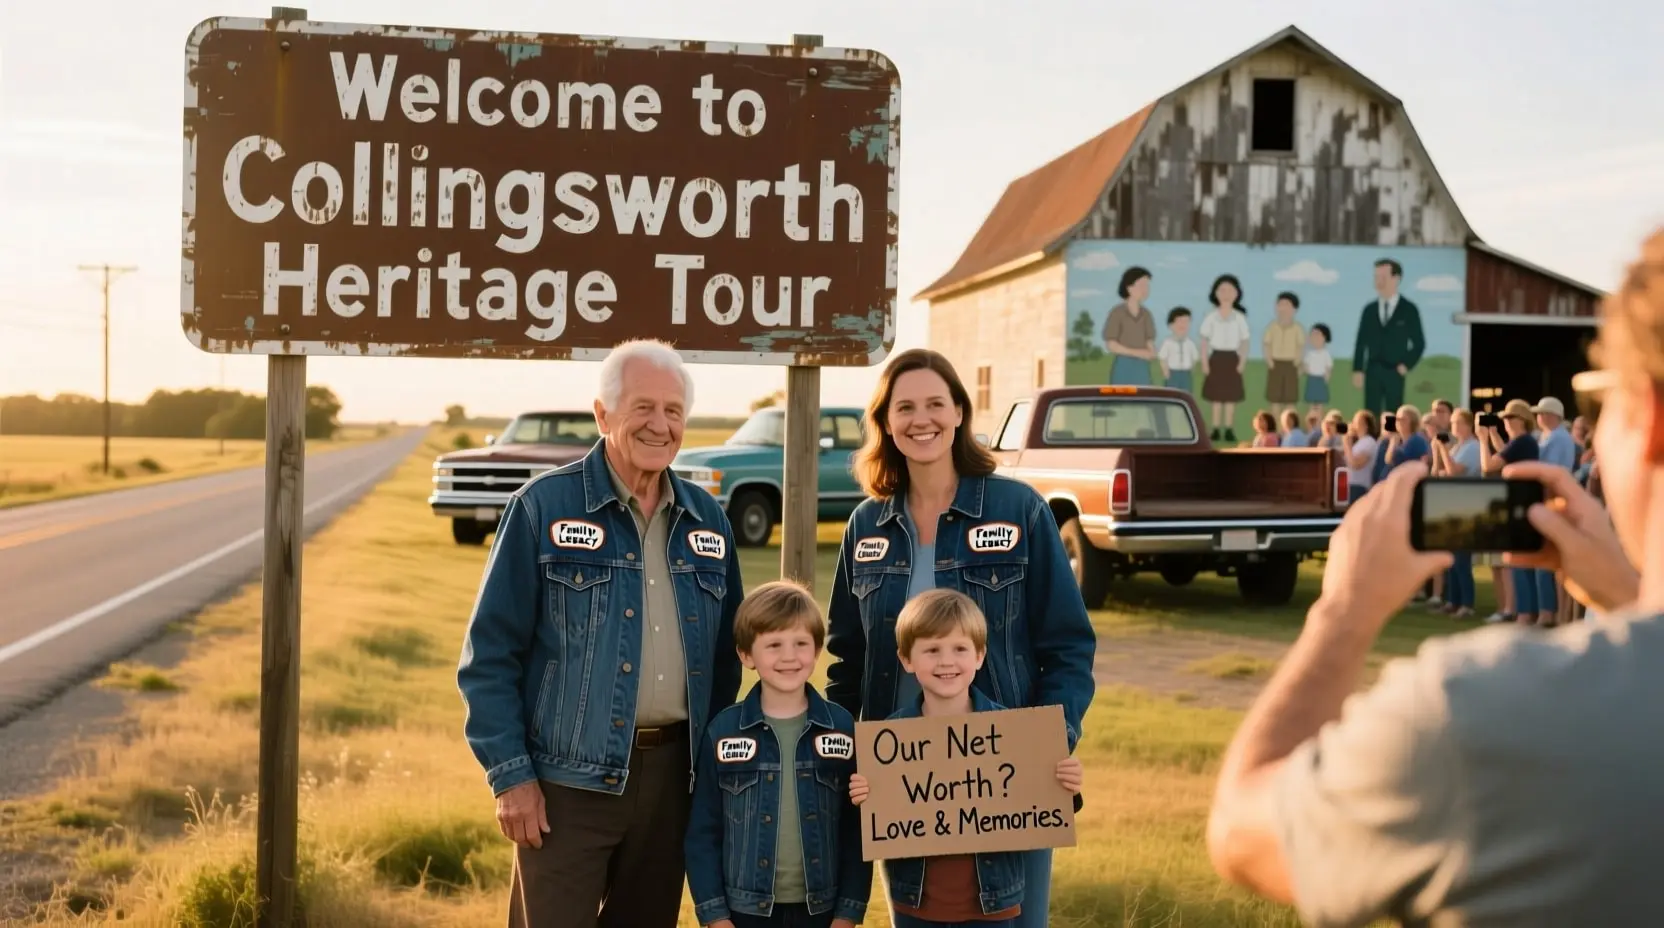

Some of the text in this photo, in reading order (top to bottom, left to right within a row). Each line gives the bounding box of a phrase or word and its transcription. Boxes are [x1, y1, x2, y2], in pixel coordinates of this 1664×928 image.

[330, 51, 767, 137] Welcome to
[222, 135, 864, 253] Collingsworth
[262, 242, 832, 341] Heritage Tour
[873, 723, 1003, 765] Our Net
[901, 762, 1015, 804] Worth?
[871, 805, 1069, 842] Love & Memories.
